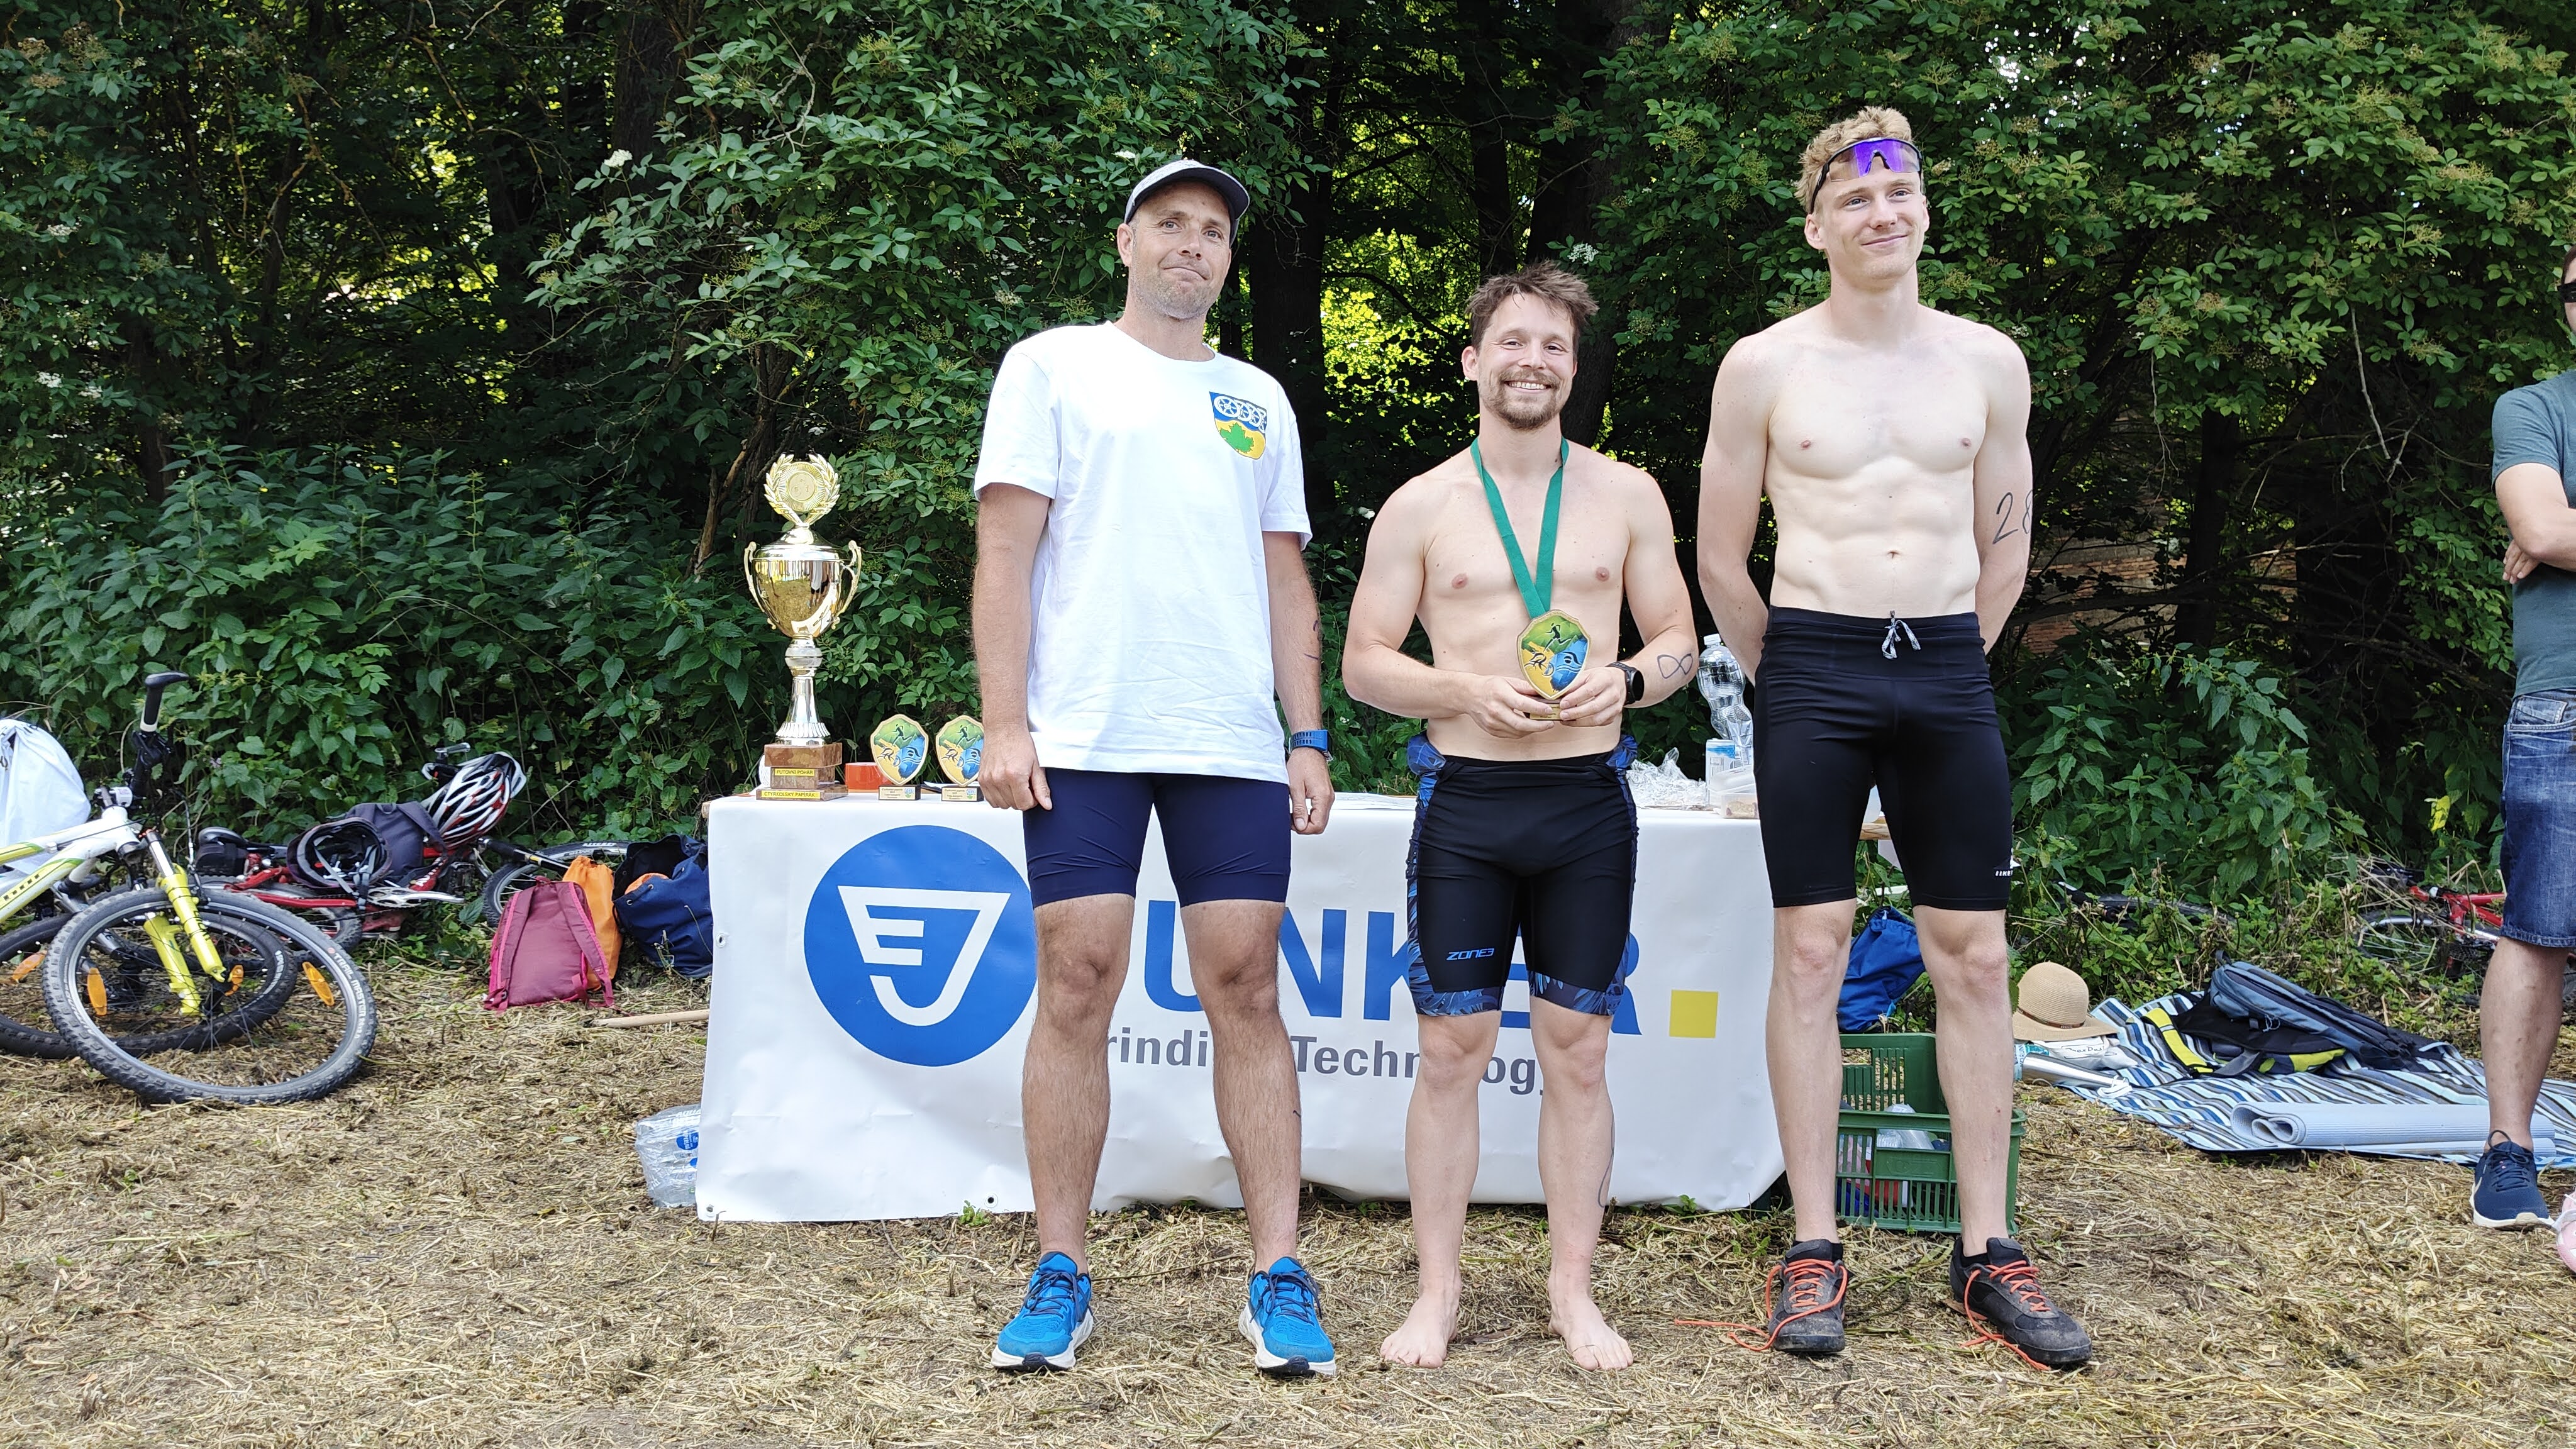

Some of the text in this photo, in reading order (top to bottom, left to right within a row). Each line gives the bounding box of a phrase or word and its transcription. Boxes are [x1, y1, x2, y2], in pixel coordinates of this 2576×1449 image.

[1992, 489, 2033, 545] 28
[333, 952, 354, 980] TRAIL
[351, 979, 367, 1017] MASTER
[1145, 900, 1643, 1036] UNK
[1107, 1027, 1543, 1096] rindi Technog
